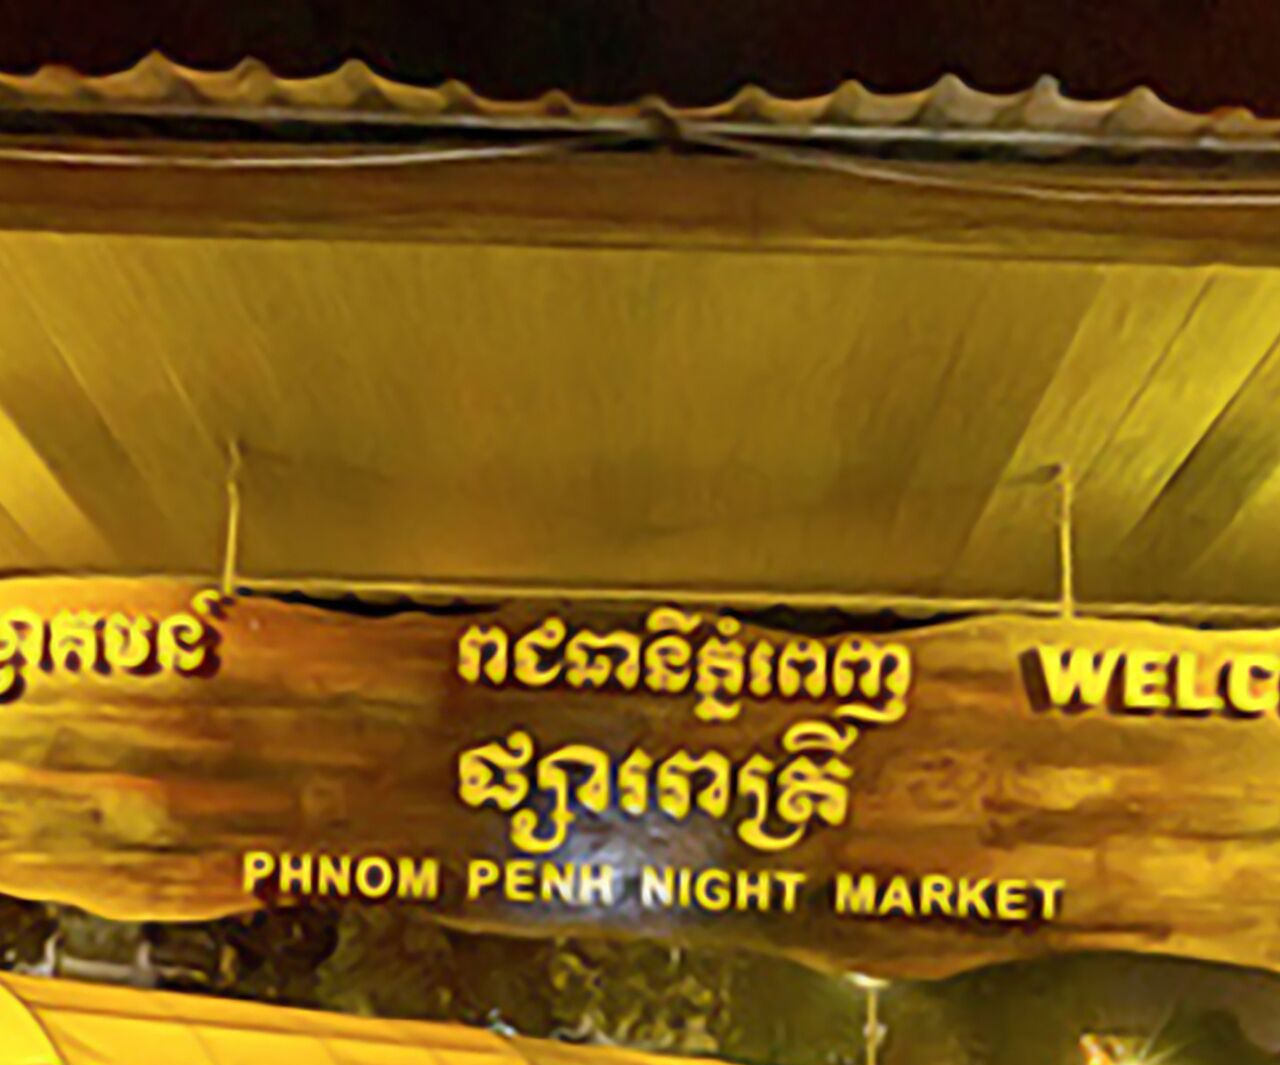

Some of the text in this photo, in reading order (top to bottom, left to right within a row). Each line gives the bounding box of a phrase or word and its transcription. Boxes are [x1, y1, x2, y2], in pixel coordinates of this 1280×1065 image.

[458, 607, 912, 723] រាជធានីភ្នំពេញ
[458, 721, 858, 852] ផ្សាររាត្រី
[243, 851, 1066, 920] PHNOM PENH NIGHT MARKET
